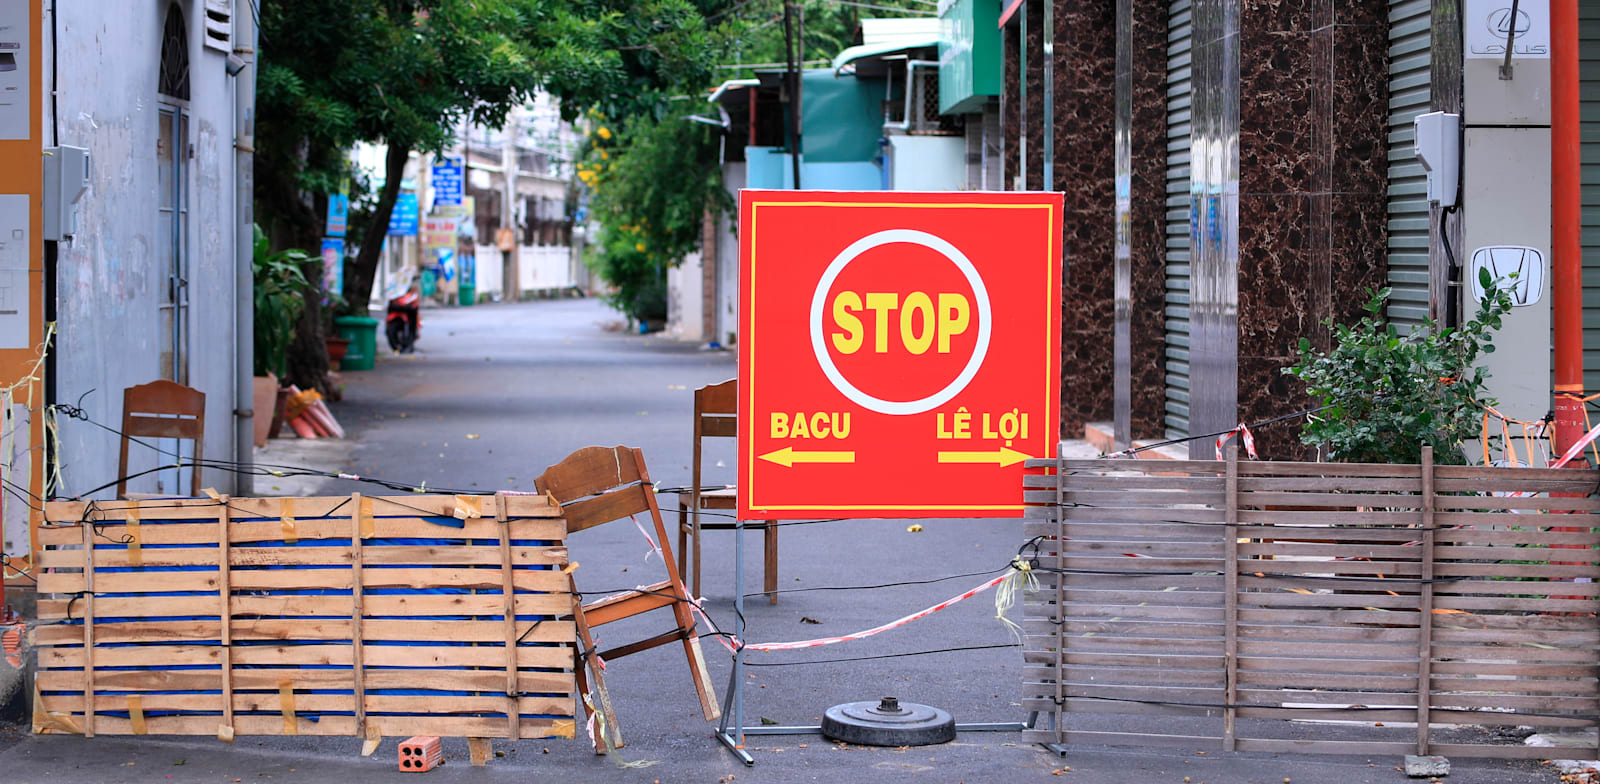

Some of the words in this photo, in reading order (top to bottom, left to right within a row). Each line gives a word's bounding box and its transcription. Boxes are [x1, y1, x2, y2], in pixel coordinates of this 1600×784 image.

[832, 291, 970, 354] STOP
[771, 412, 850, 439] BACU
[937, 407, 971, 438] LÊ
[983, 408, 1028, 446] LỢI
